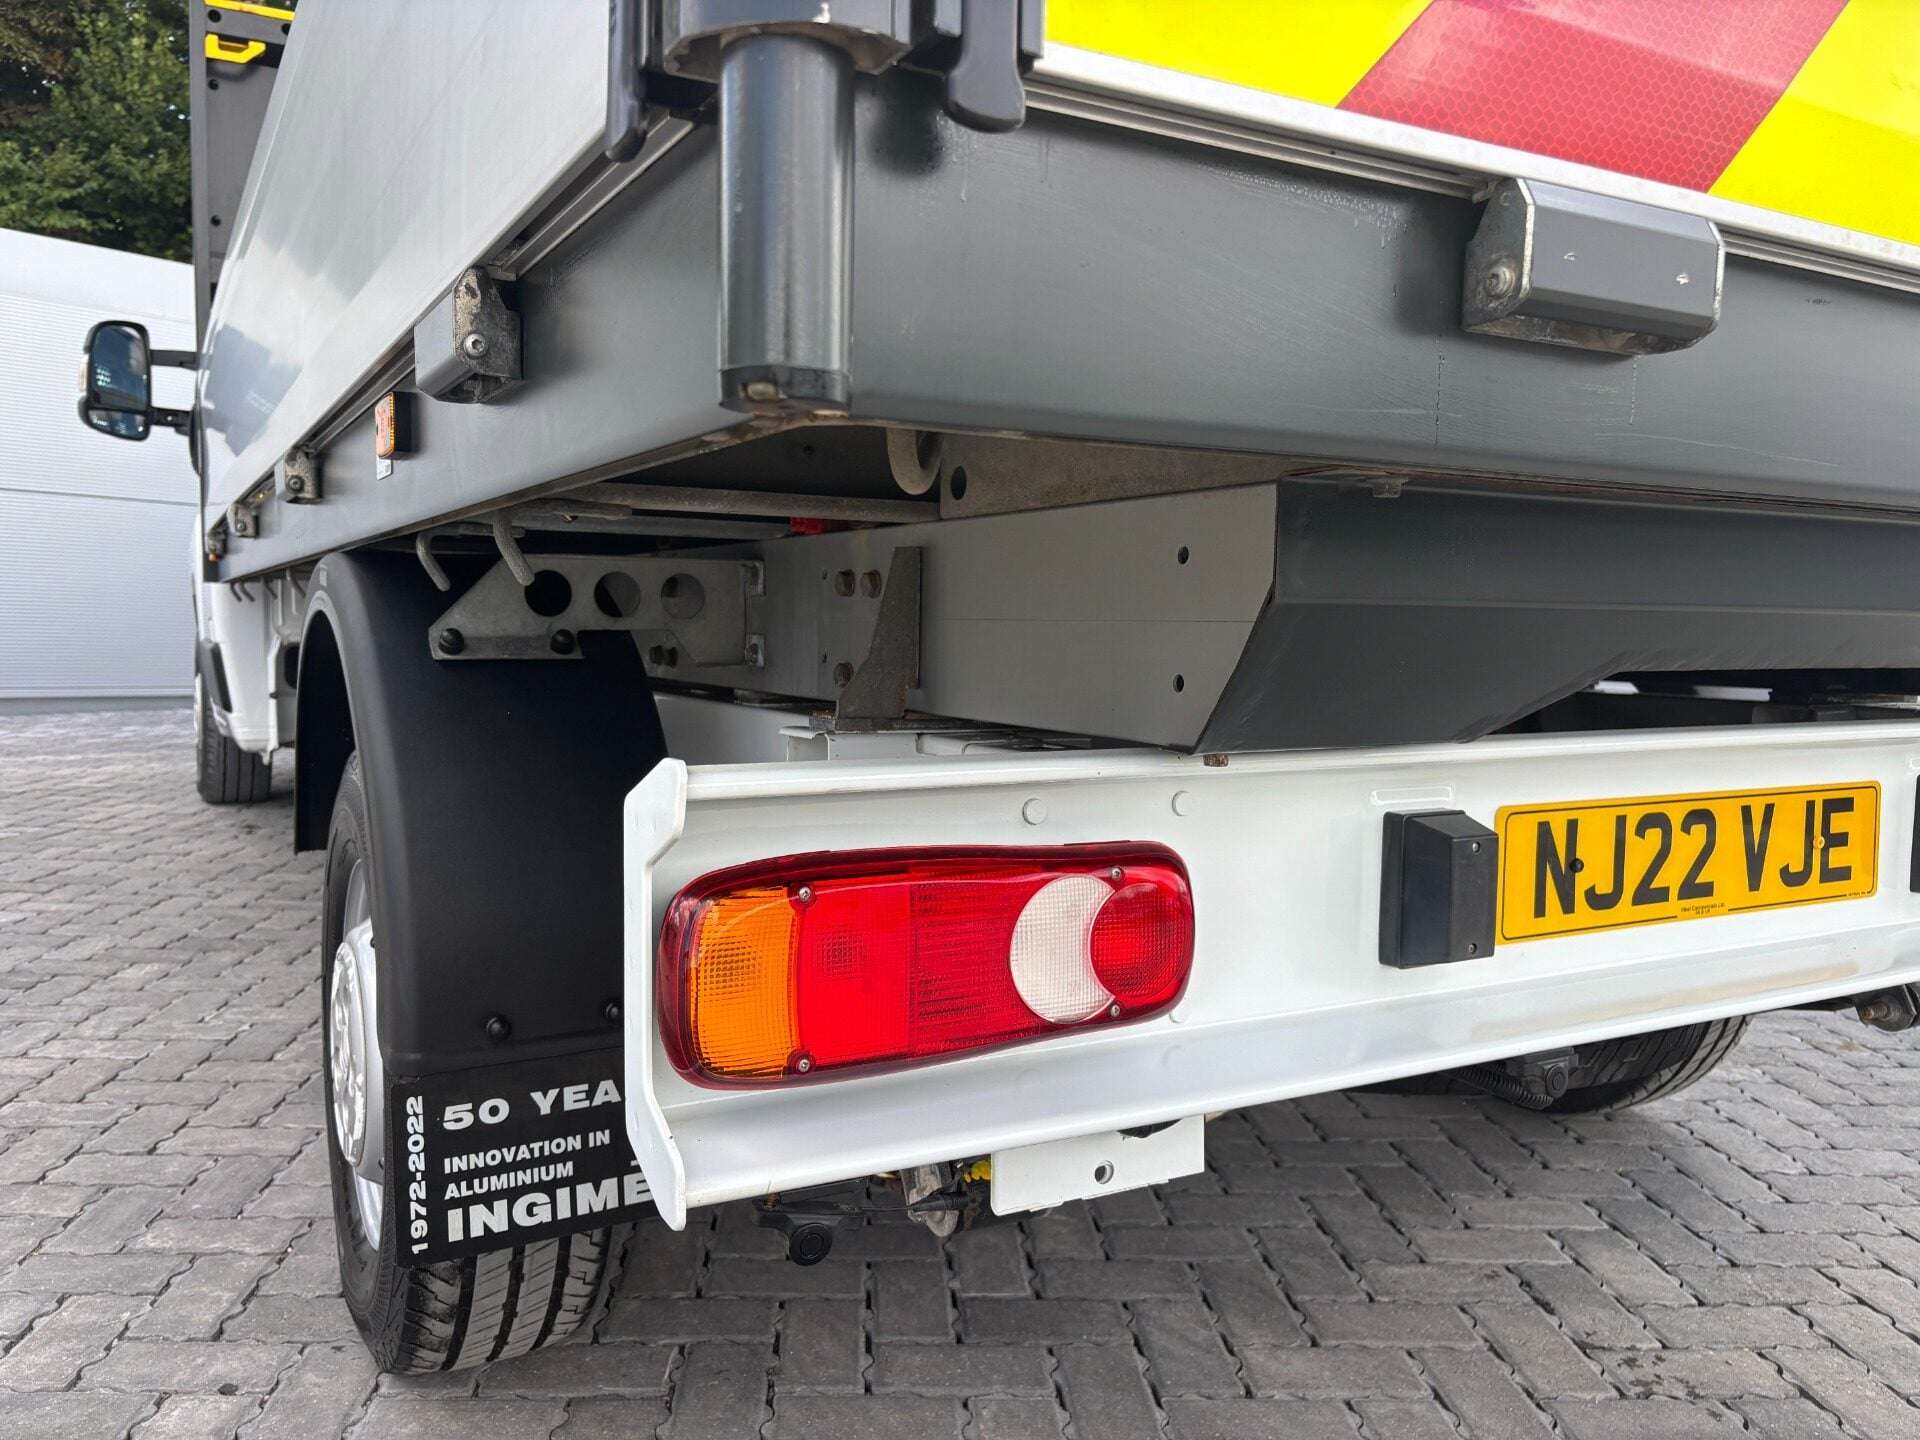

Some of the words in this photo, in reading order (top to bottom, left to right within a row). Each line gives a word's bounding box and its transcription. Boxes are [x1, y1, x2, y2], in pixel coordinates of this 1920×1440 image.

[1533, 808, 1718, 919] NJ22
[1740, 797, 1855, 893] VJE
[442, 1097, 510, 1131] 50
[530, 1079, 622, 1116] YEA
[405, 1095, 429, 1256] 1972-2022
[443, 1134, 582, 1175] INNOVATION
[588, 1129, 611, 1149] IN
[443, 1161, 574, 1200] ALUMINIUM
[447, 1171, 654, 1243] INGIME
